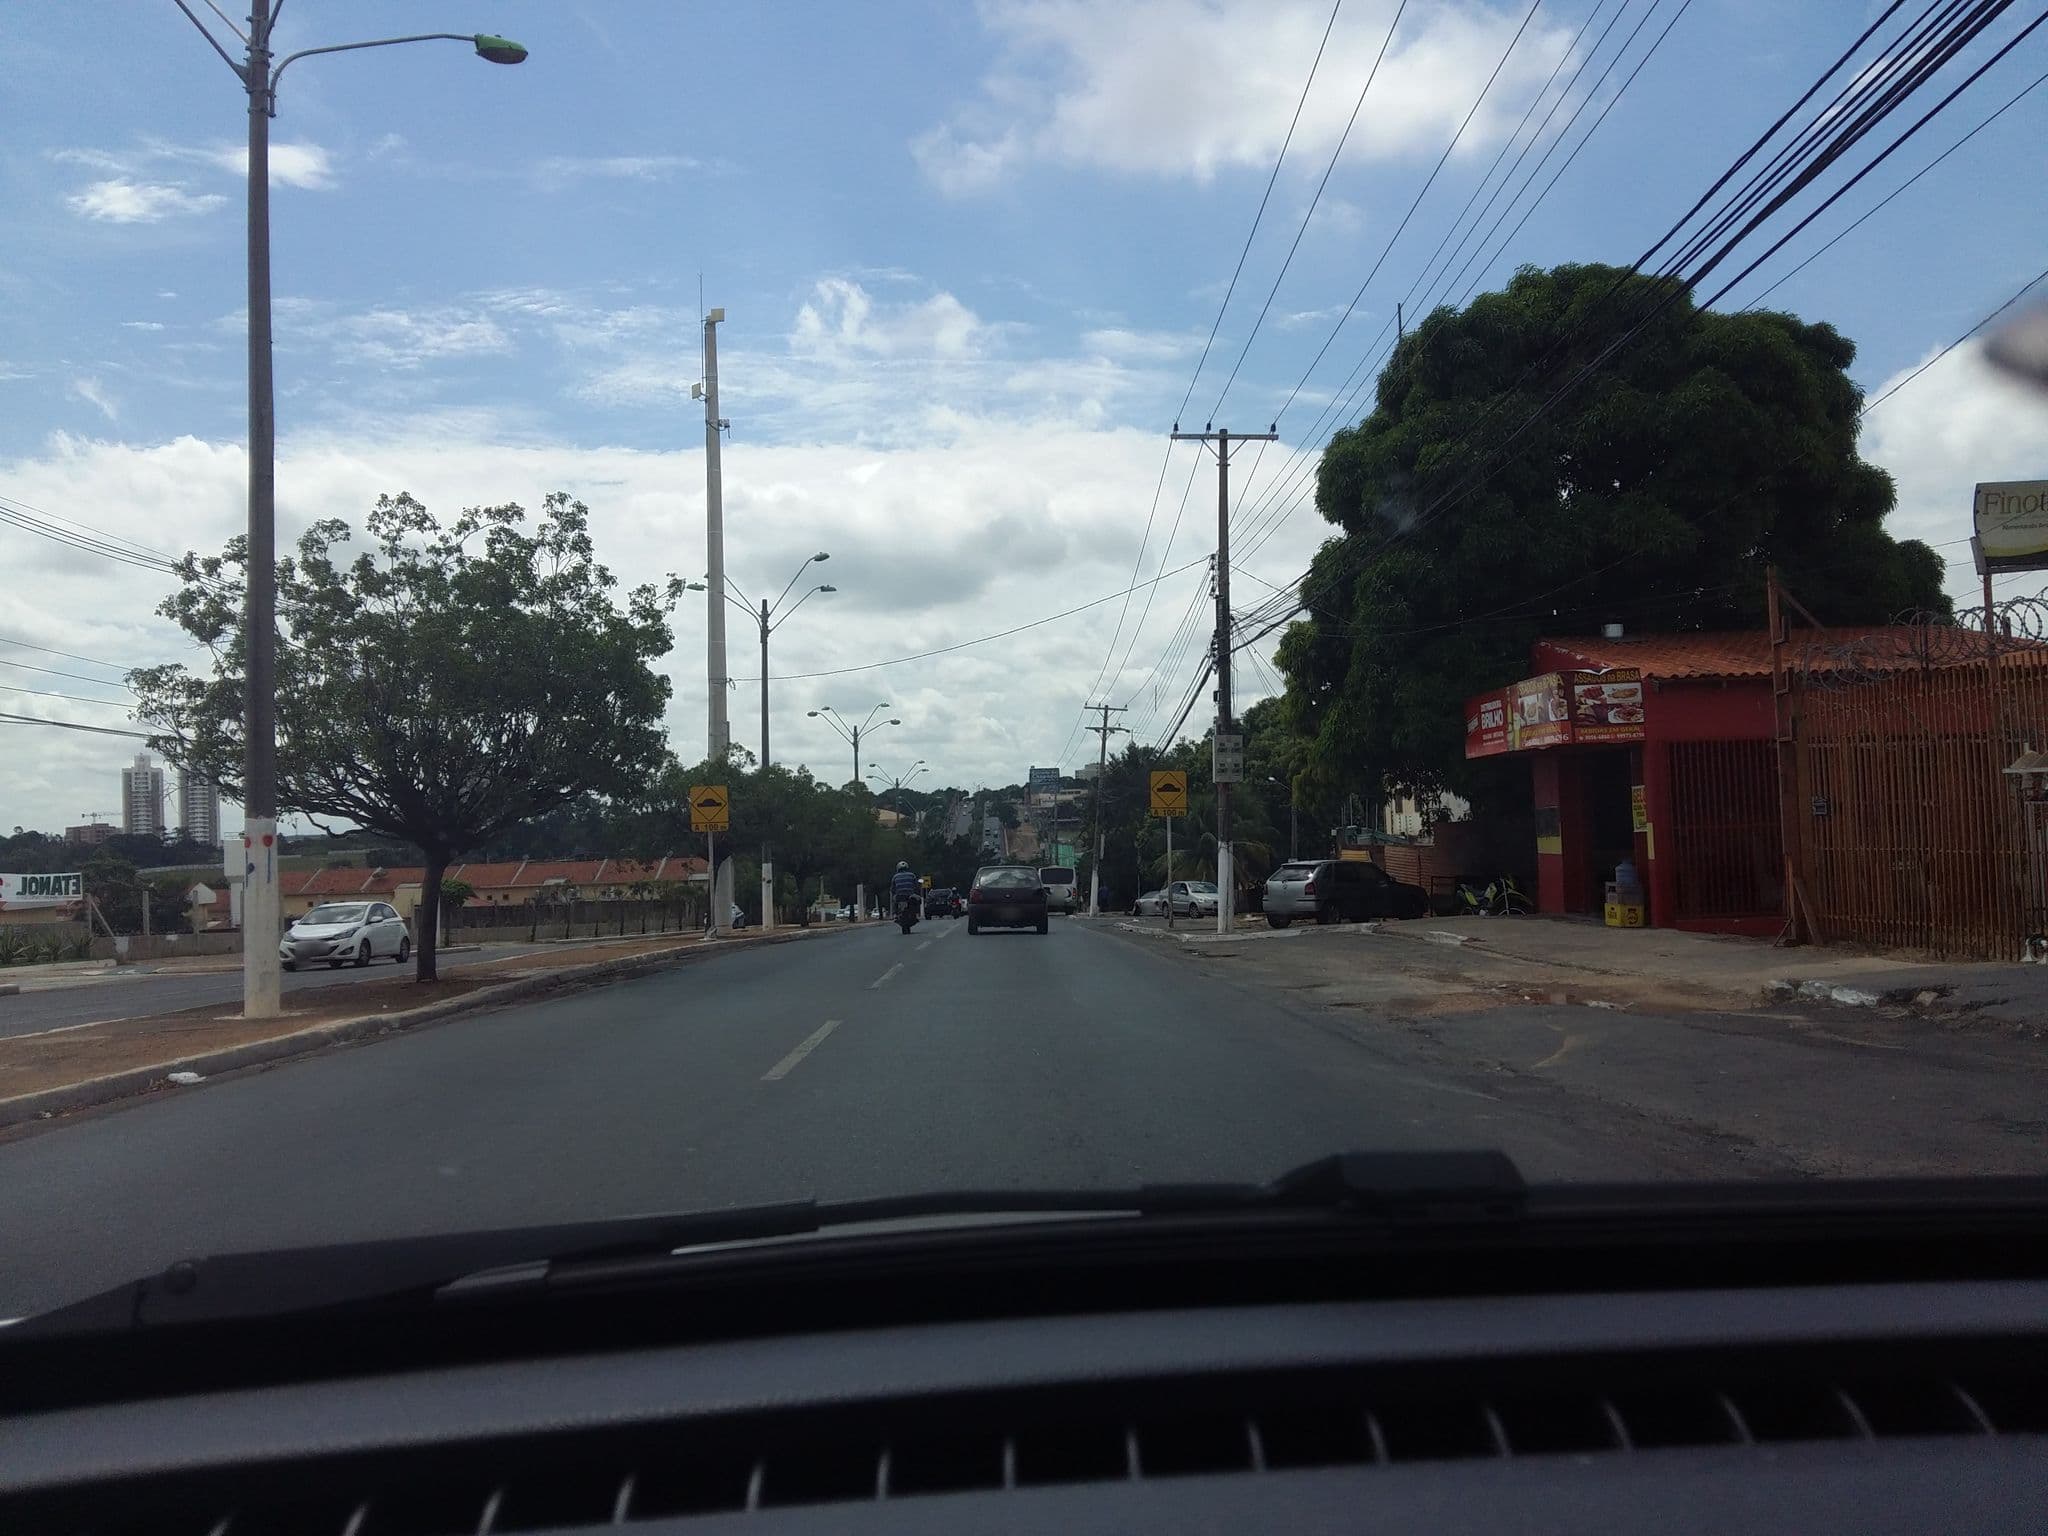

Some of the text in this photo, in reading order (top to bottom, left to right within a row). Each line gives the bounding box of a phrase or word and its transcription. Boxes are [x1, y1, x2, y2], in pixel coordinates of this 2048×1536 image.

[1983, 491, 2048, 515] Finot
[1616, 670, 1640, 681] BRASA
[704, 823, 719, 831] 100
